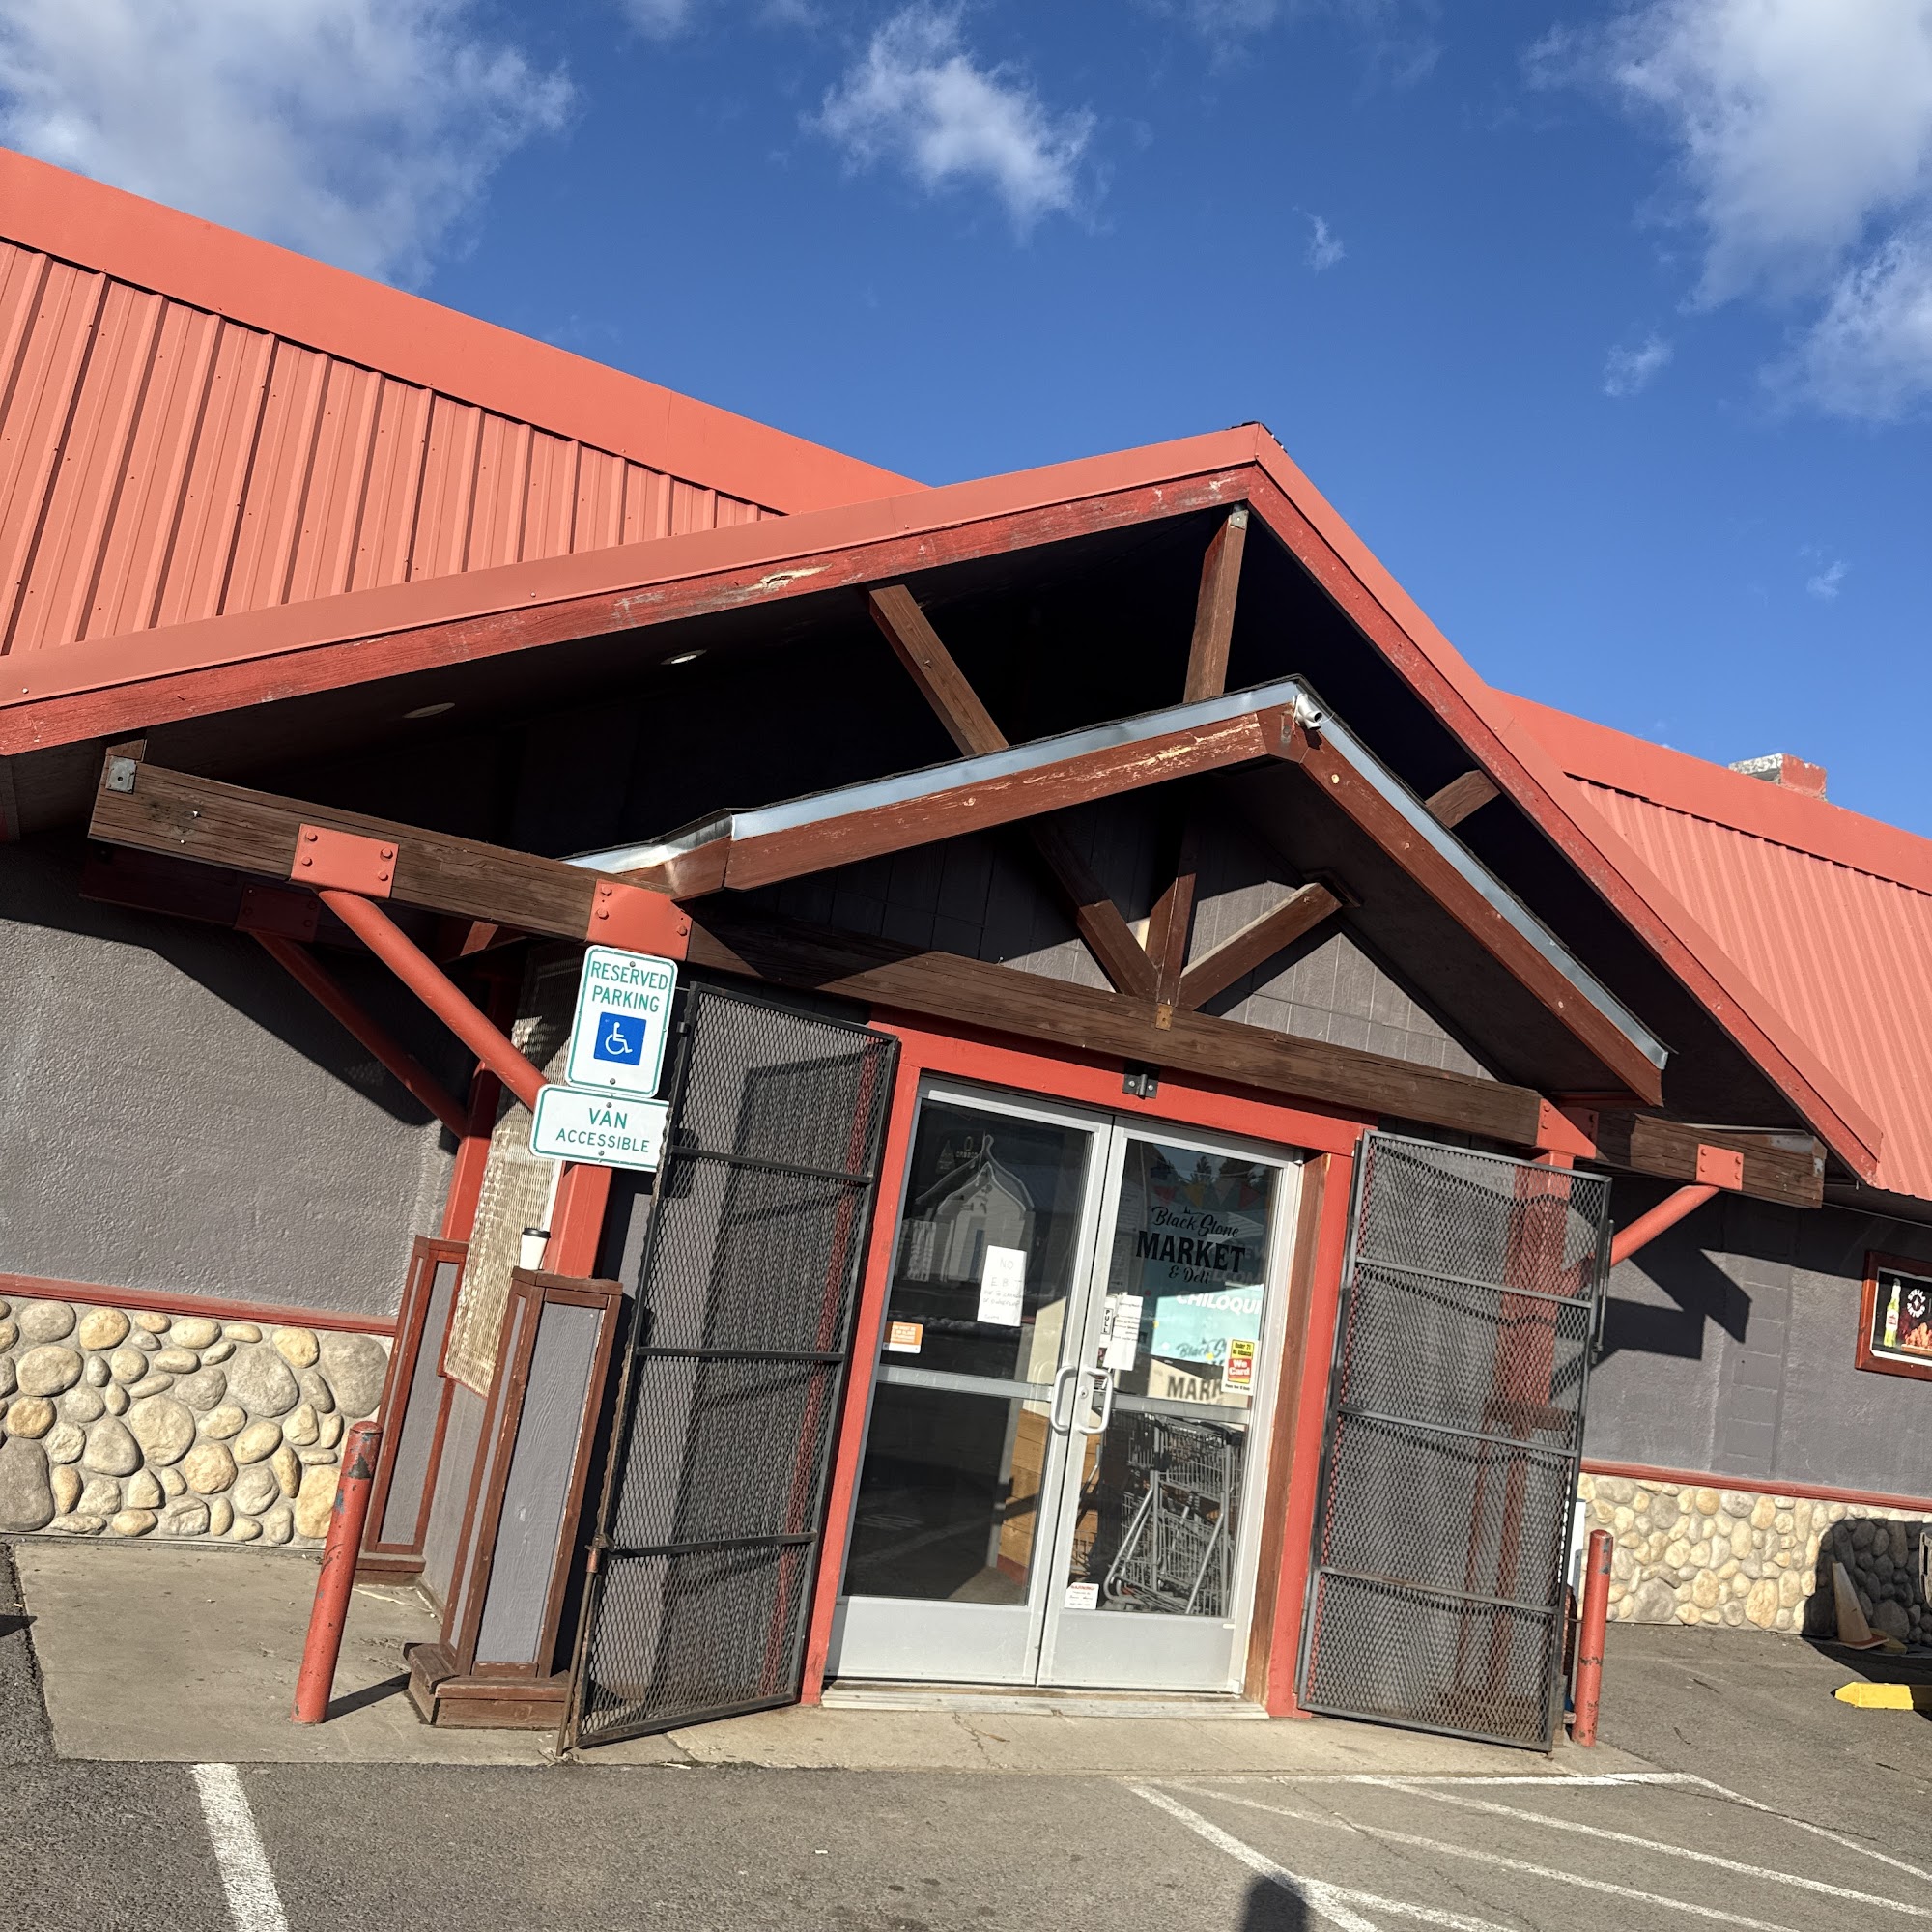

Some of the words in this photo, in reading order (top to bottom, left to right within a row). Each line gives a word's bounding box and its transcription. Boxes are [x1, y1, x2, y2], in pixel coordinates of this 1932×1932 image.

[590, 960, 668, 990] RESERVED
[591, 984, 660, 1013] PARKING
[589, 1107, 628, 1130] VAN
[555, 1127, 650, 1153] ACCESSIBLE
[1151, 1206, 1196, 1231] Black
[999, 1257, 1014, 1270] NO
[1136, 1230, 1246, 1273] MARKET
[1169, 1264, 1179, 1279] &
[1183, 1266, 1209, 1285] Deli
[1232, 1359, 1248, 1368] We
